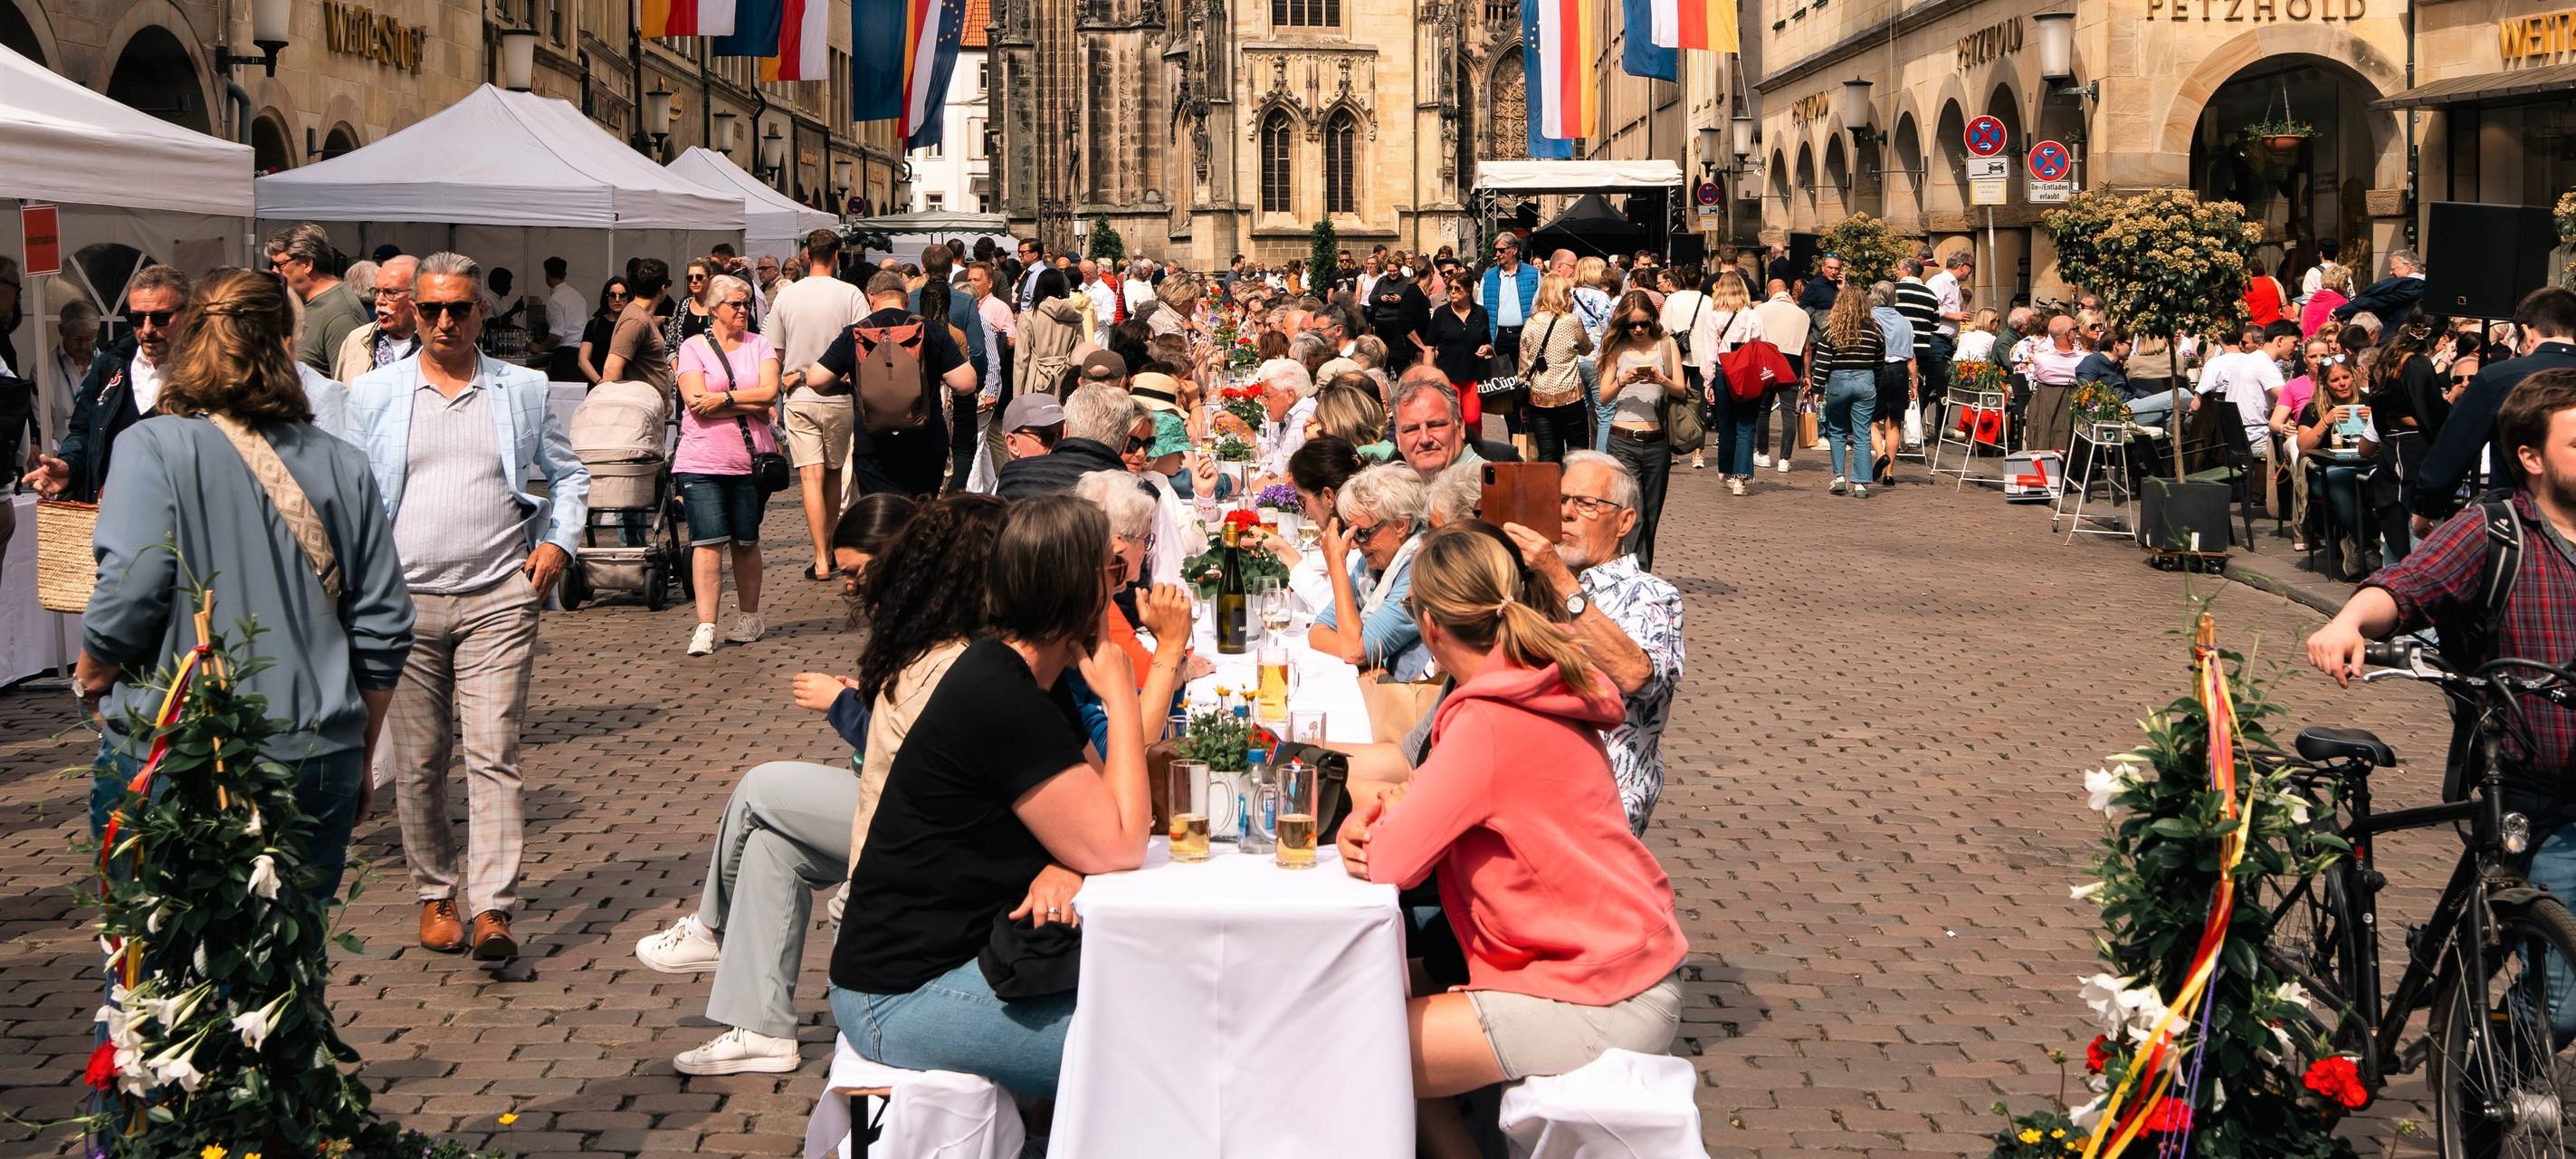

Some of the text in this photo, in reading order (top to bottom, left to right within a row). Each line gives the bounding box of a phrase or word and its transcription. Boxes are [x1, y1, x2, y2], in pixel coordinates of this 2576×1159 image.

[2145, 0, 2367, 21] PETZHOLD
[1957, 15, 2024, 70] PETZHOLD
[2039, 192, 2060, 200] erlaubt
